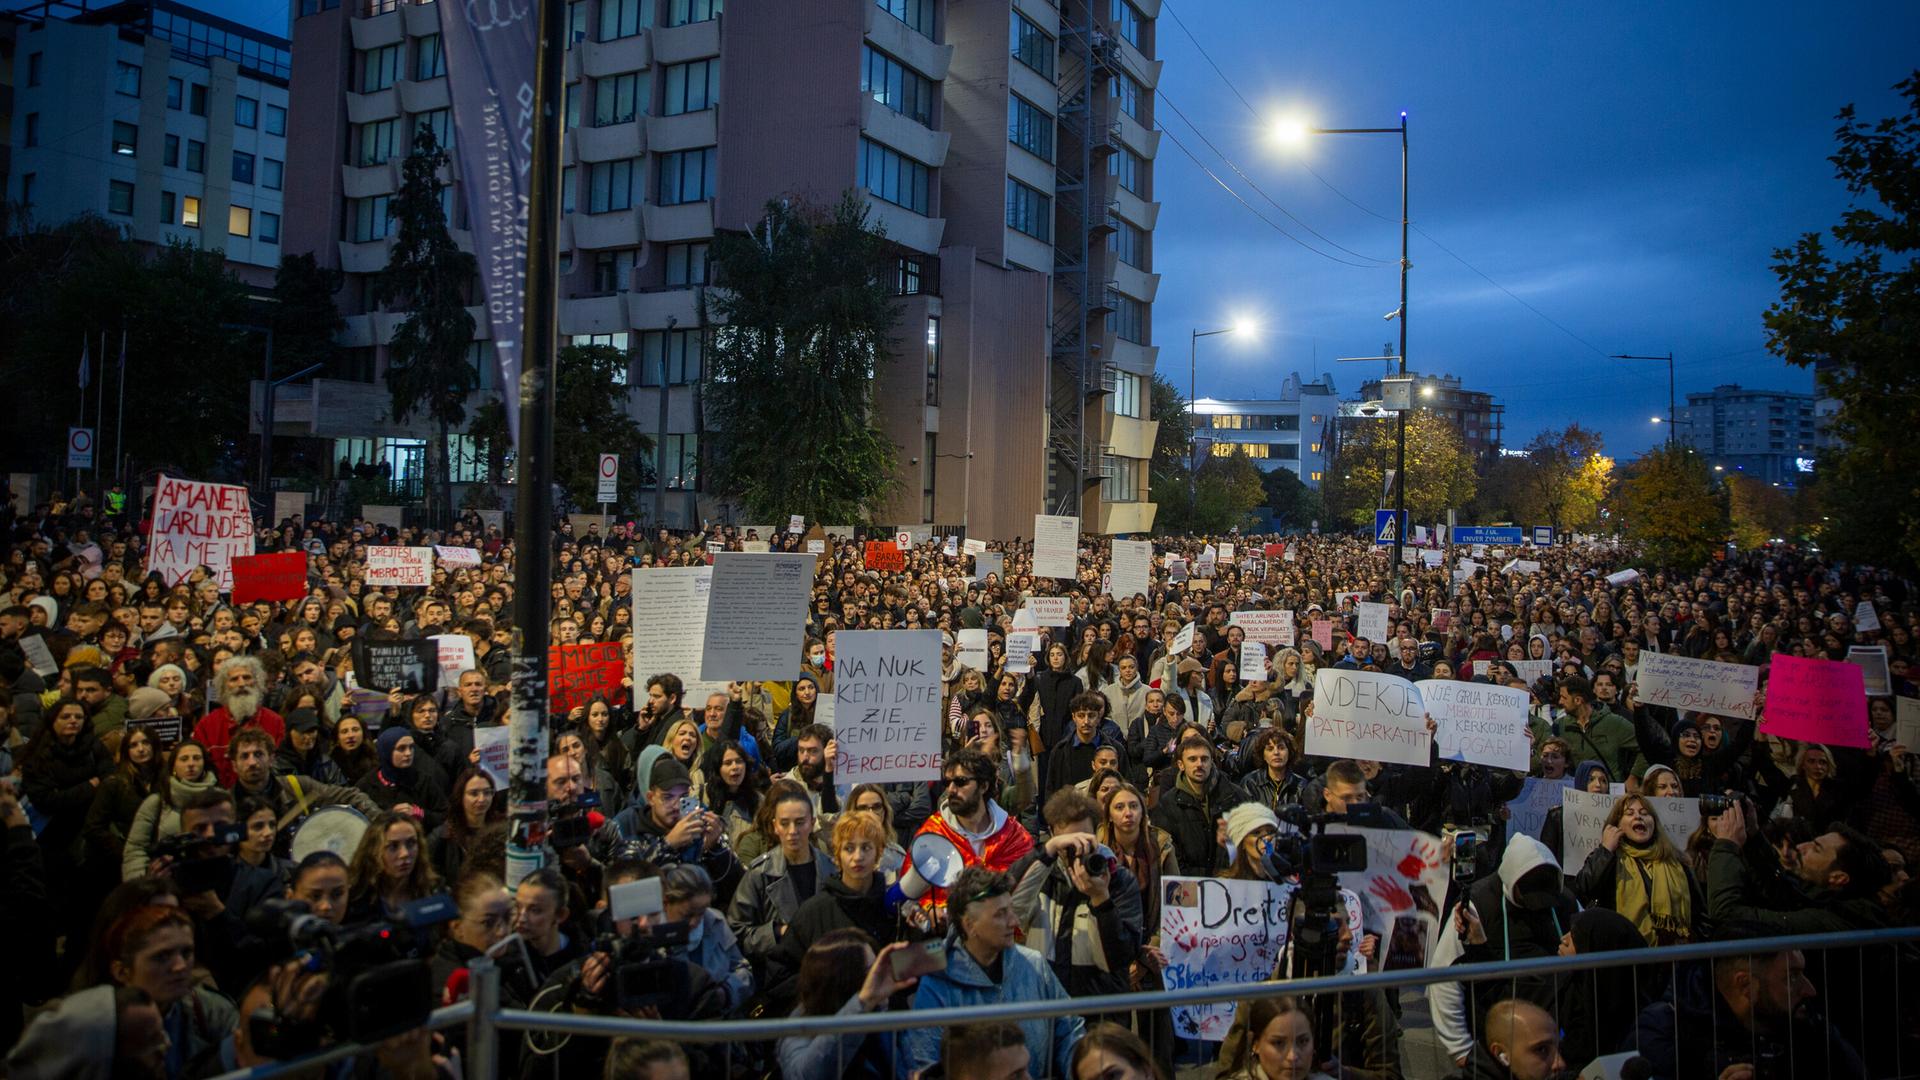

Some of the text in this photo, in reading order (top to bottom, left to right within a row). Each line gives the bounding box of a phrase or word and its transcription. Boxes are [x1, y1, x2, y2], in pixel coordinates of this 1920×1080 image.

[154, 539, 175, 564] KA
[185, 540, 219, 566] ME
[838, 655, 925, 679] NA NUK
[837, 682, 885, 704] KEMI
[1319, 676, 1421, 719] VDEKJE
[835, 722, 928, 744] KEMI DITË
